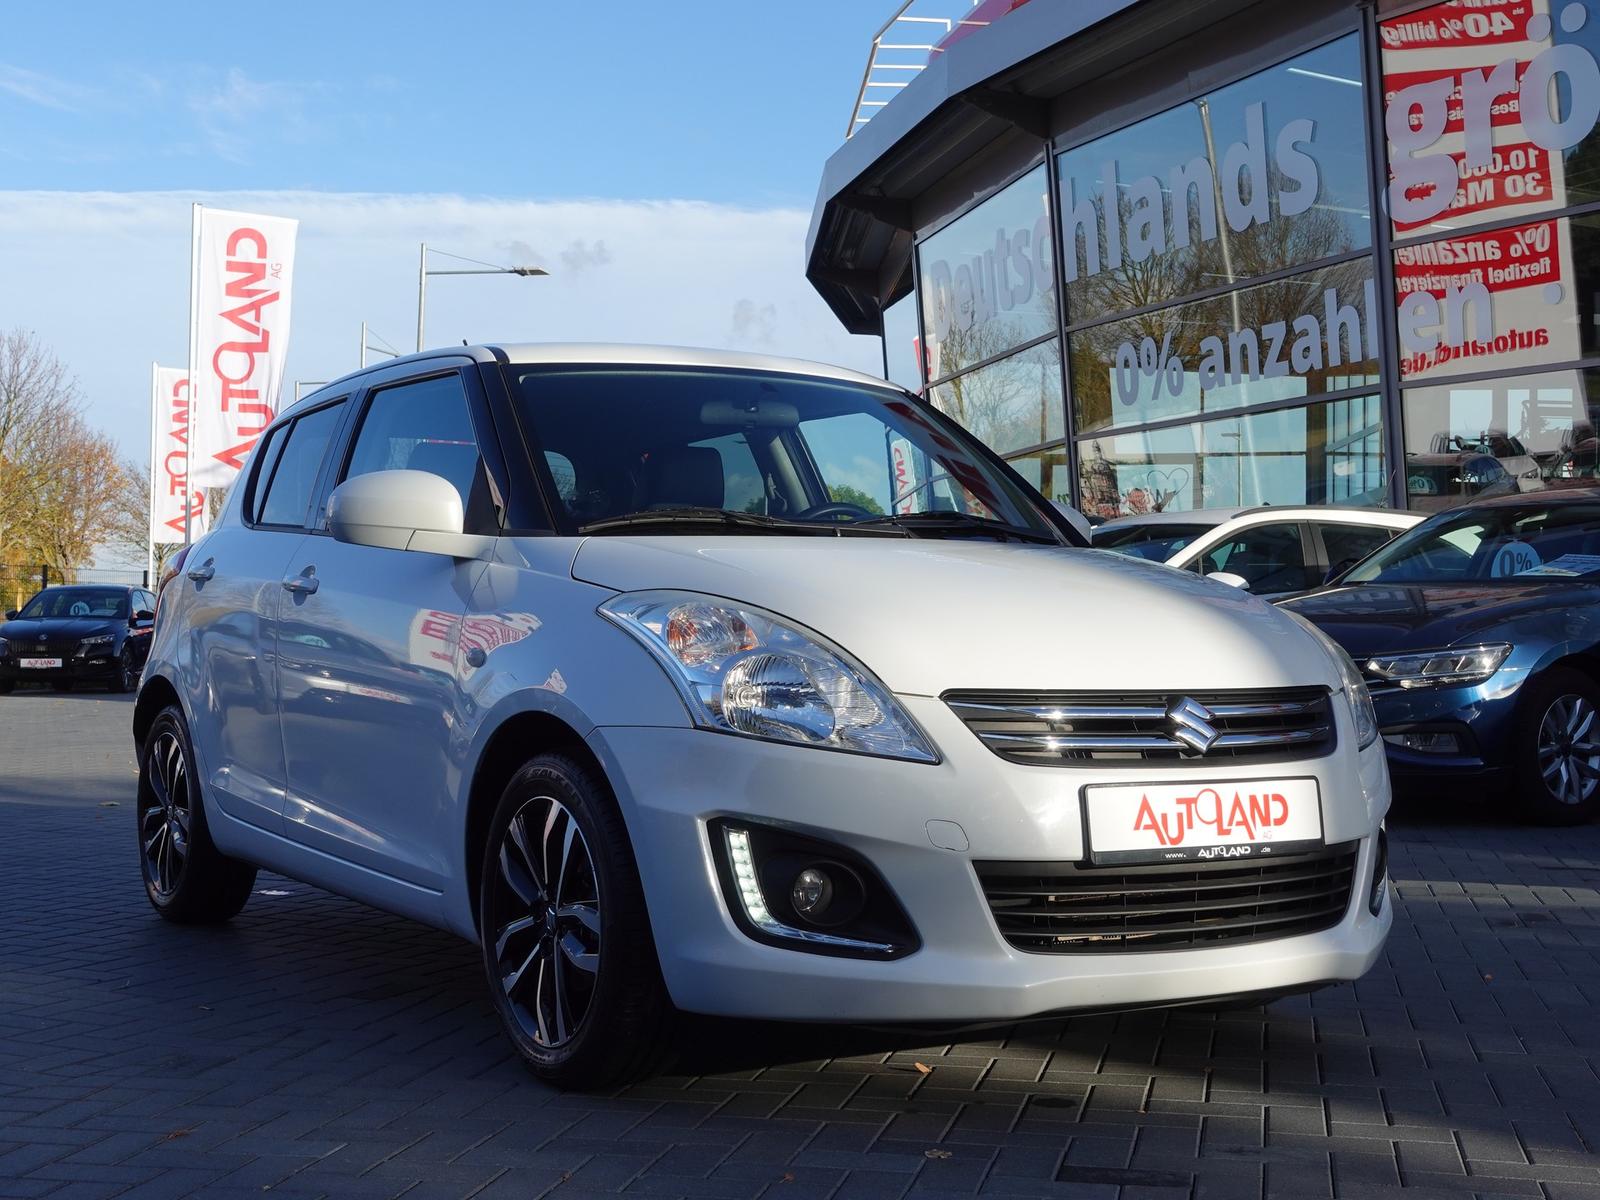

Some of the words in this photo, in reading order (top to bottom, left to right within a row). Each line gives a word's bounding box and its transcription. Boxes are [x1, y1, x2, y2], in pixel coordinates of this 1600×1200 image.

[930, 101, 1321, 342] Deutschlands
[270, 262, 282, 279] AG
[1115, 331, 1185, 407] 0%
[1200, 279, 1493, 391] anzahlen
[1501, 550, 1533, 577] 0%
[1133, 788, 1289, 846] AUTOLAND
[1198, 846, 1251, 859] AUTOLAND
